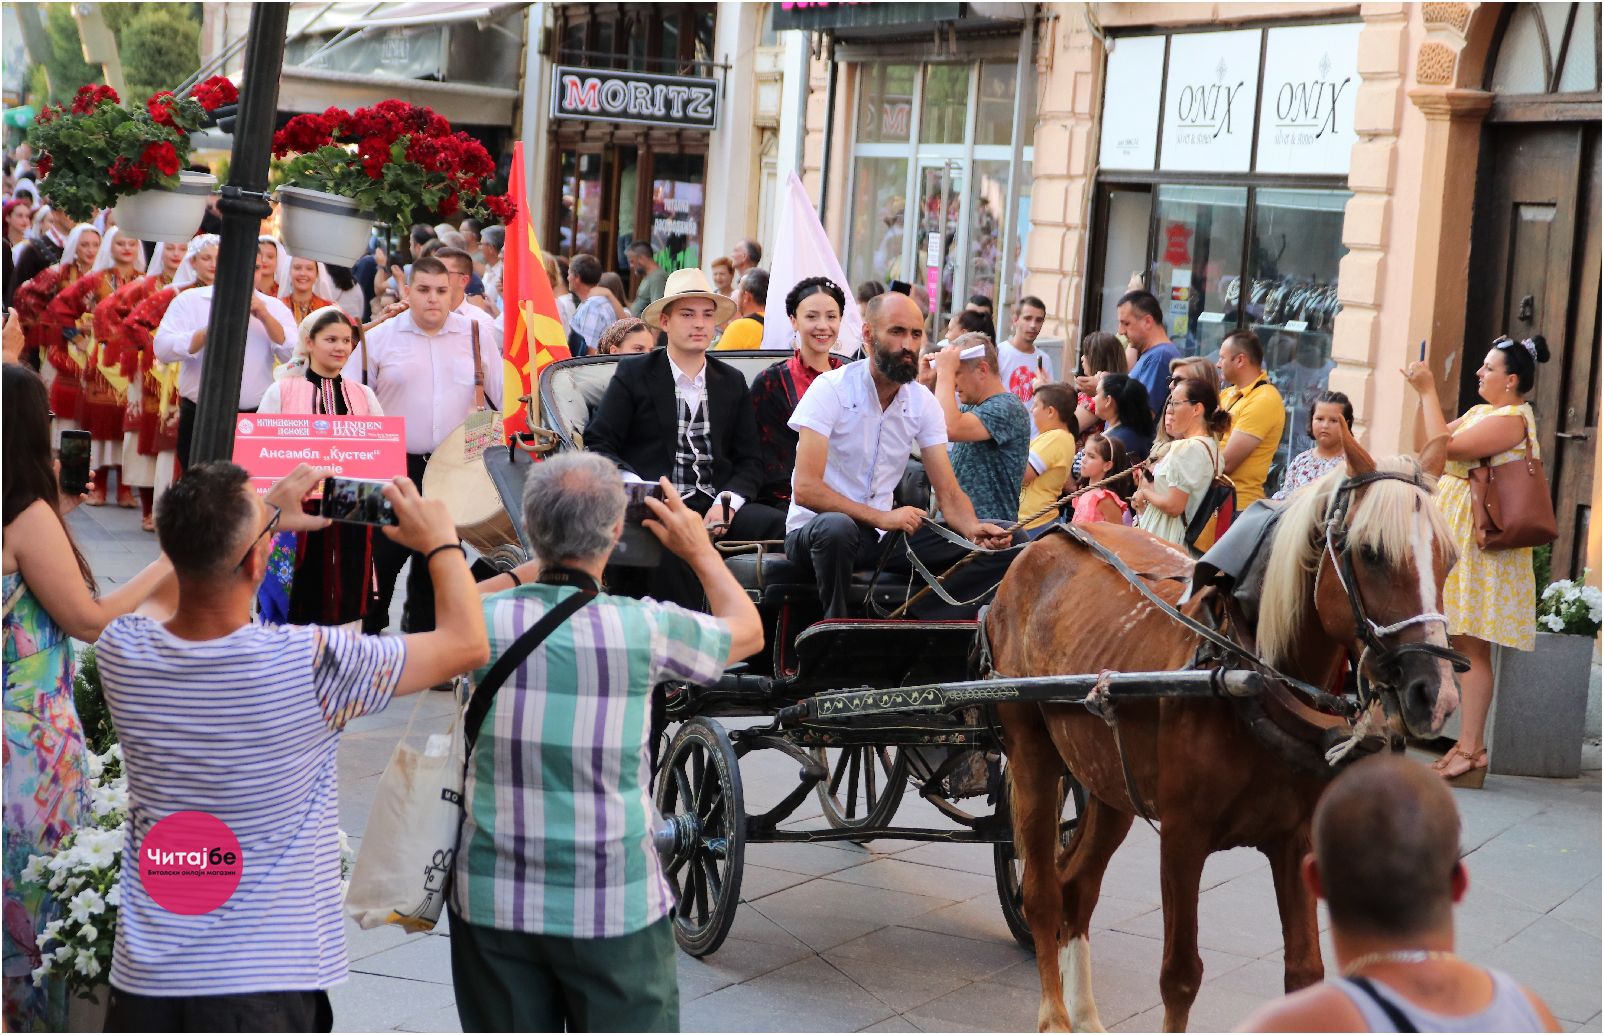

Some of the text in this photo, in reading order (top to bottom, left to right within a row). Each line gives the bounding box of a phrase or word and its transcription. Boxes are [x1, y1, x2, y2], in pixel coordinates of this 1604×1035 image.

[562, 74, 714, 119] MORITZ
[1178, 81, 1244, 138] ONIX
[1276, 77, 1350, 138] ONIX
[332, 420, 382, 430] ILINDEN
[333, 427, 366, 437] DAYS
[259, 447, 320, 459] Ансамбл
